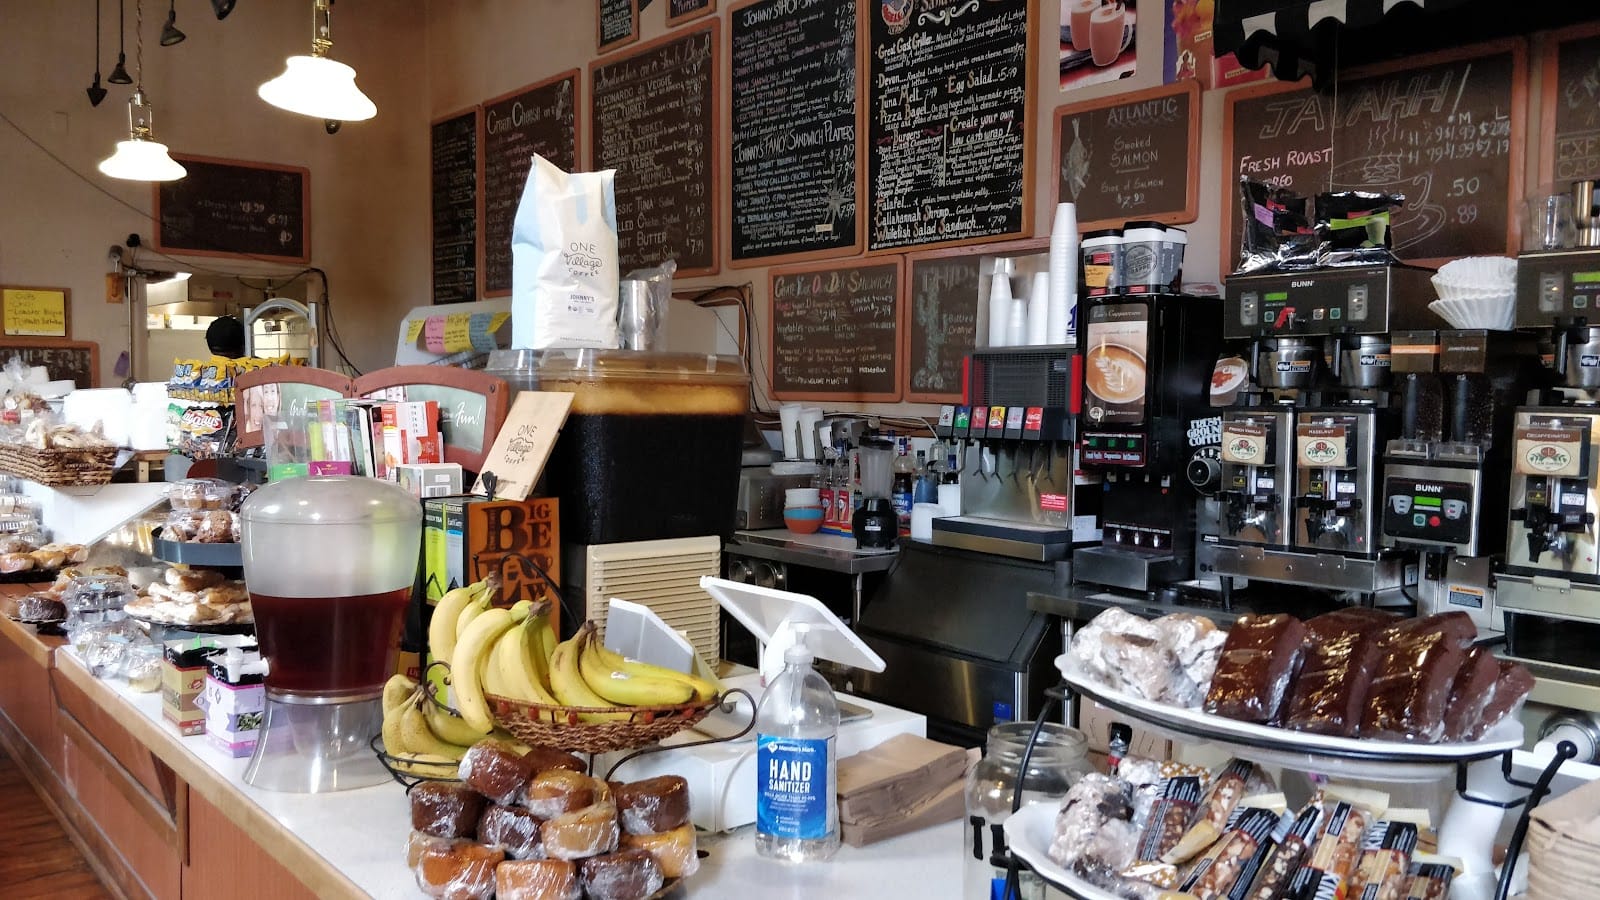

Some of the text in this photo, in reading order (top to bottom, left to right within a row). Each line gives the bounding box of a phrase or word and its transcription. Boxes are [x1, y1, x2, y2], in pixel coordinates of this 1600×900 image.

[878, 43, 896, 59] Great
[976, 15, 1001, 32] president
[878, 95, 898, 110] Tuna
[899, 88, 919, 105] Melt
[947, 75, 965, 94] Egg
[967, 66, 993, 88] Salad
[879, 110, 902, 125] Pizza
[904, 104, 928, 121] Bagel
[1107, 98, 1178, 123] ATLANTIC
[1459, 105, 1509, 124] M L
[487, 110, 511, 135] Cream
[950, 115, 978, 132] Create
[980, 113, 998, 128] your
[893, 128, 921, 144] Burgers
[952, 132, 964, 146] low
[966, 128, 983, 143] carb
[1113, 136, 1151, 151] Smoked
[1110, 150, 1159, 168] SALMON
[1240, 148, 1333, 174] FRESH ROAST
[1446, 176, 1480, 197] .50
[875, 196, 905, 212] Falafel
[923, 205, 950, 222] Shrimp
[1450, 204, 1477, 224] .89
[875, 225, 910, 241] Whitefish
[913, 221, 936, 238] Salad
[938, 215, 976, 235] Sandwich
[570, 241, 597, 254] ONE
[637, 231, 667, 247] BUTTER
[564, 252, 602, 271] Village
[456, 402, 481, 427] Fun!
[517, 424, 538, 438] ONE
[1187, 425, 1221, 438] GROUN
[1189, 434, 1221, 447] COFFE
[1415, 484, 1441, 493] BUNN
[769, 758, 812, 781] HAND
[769, 779, 810, 794] SANITIZER
